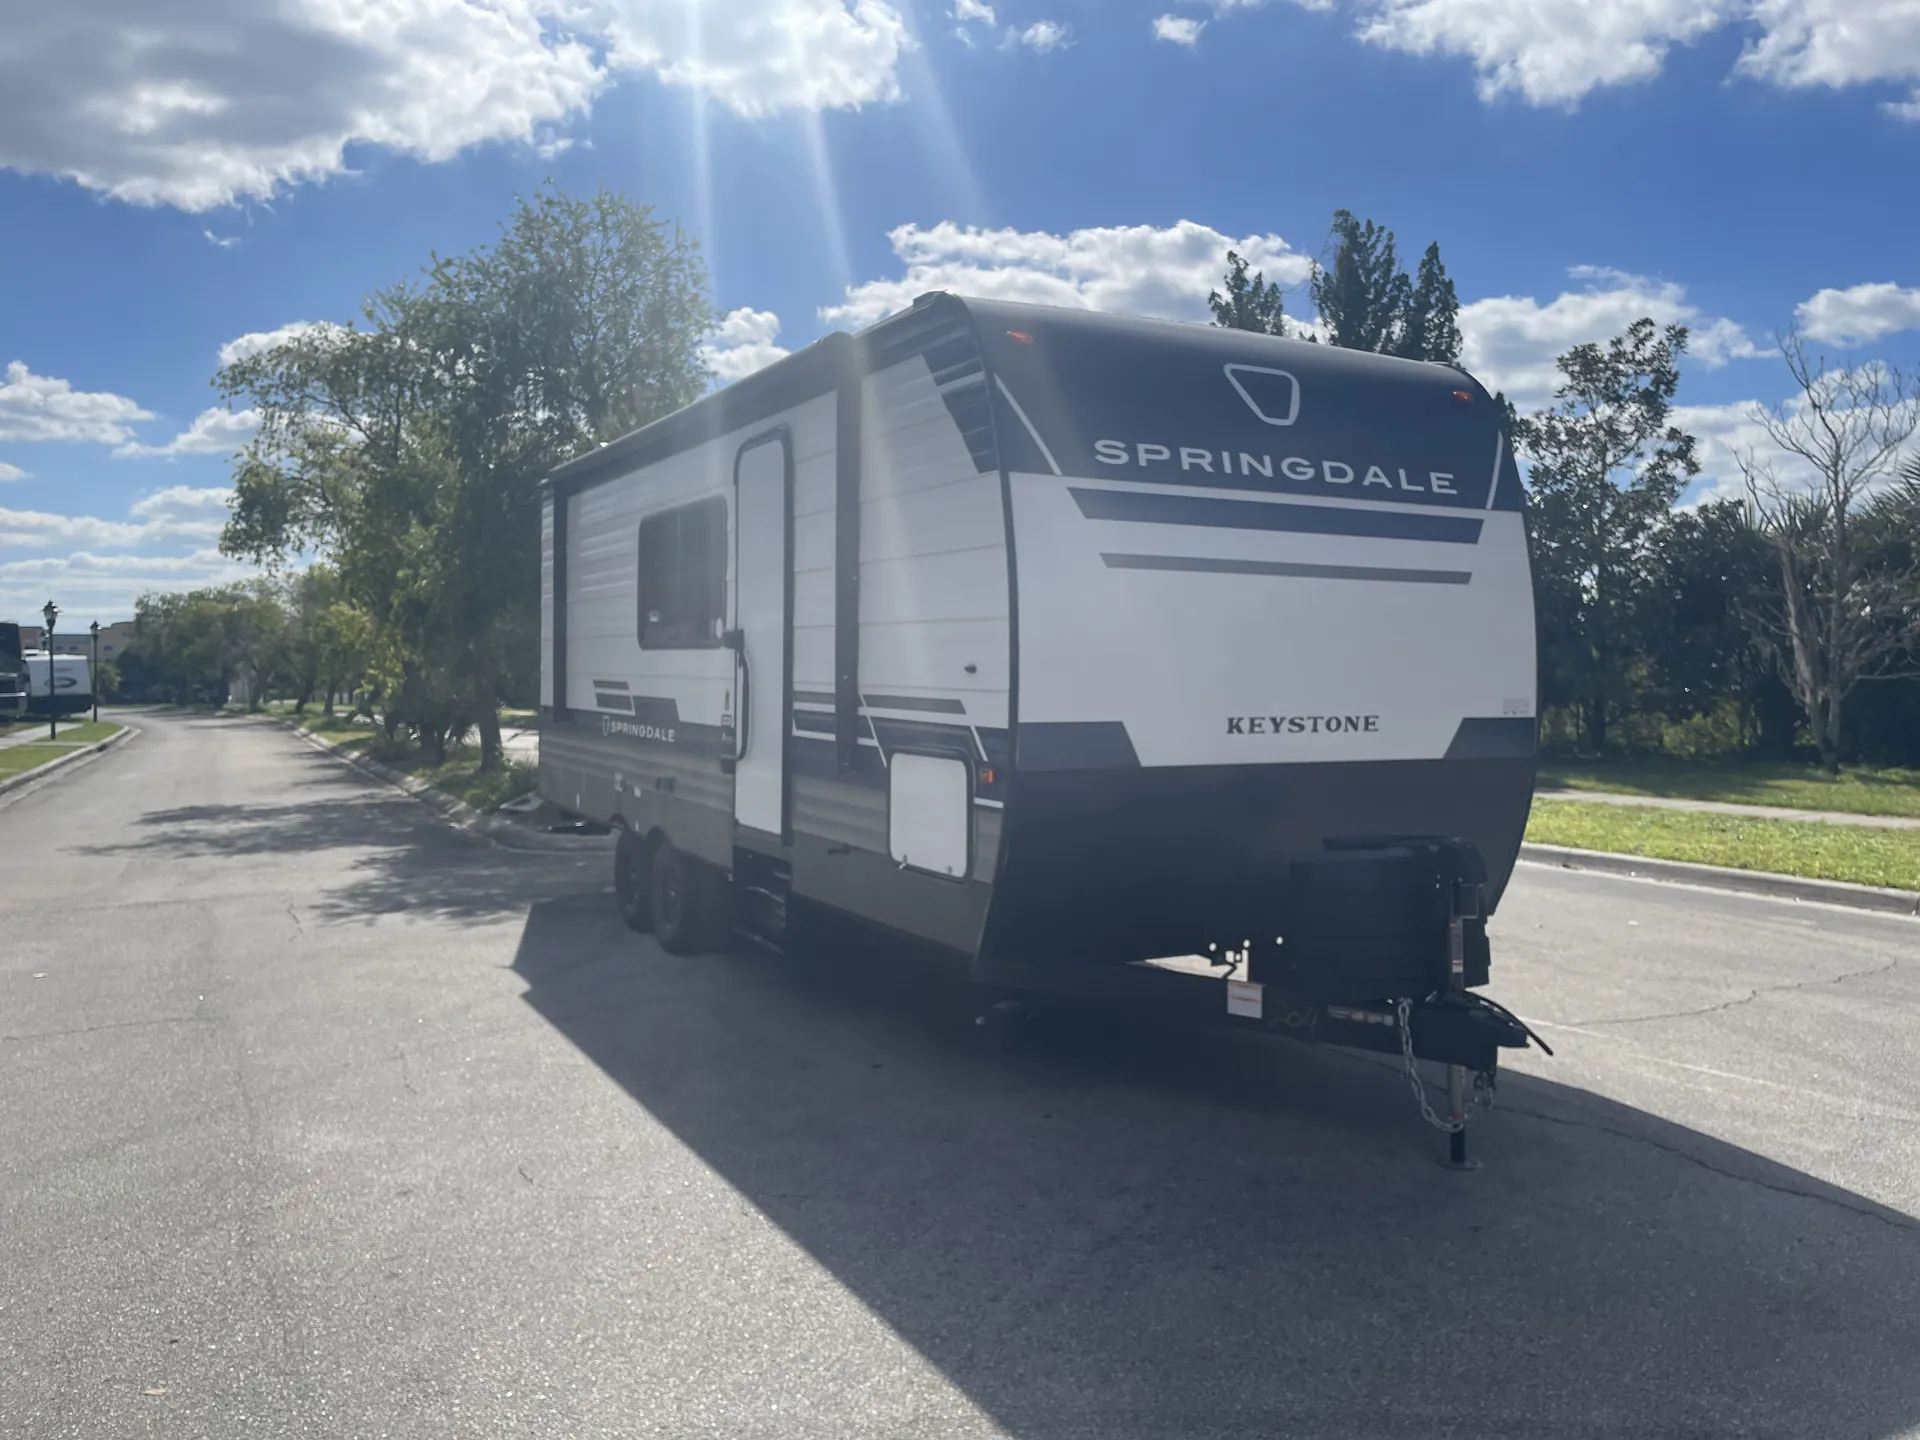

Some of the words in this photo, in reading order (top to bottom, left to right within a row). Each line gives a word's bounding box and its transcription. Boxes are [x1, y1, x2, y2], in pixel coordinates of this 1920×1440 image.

[1094, 438, 1458, 496] SPRINGDALE
[610, 722, 675, 742] SPRINGDALE
[1226, 714, 1380, 735] KEYSTONE
